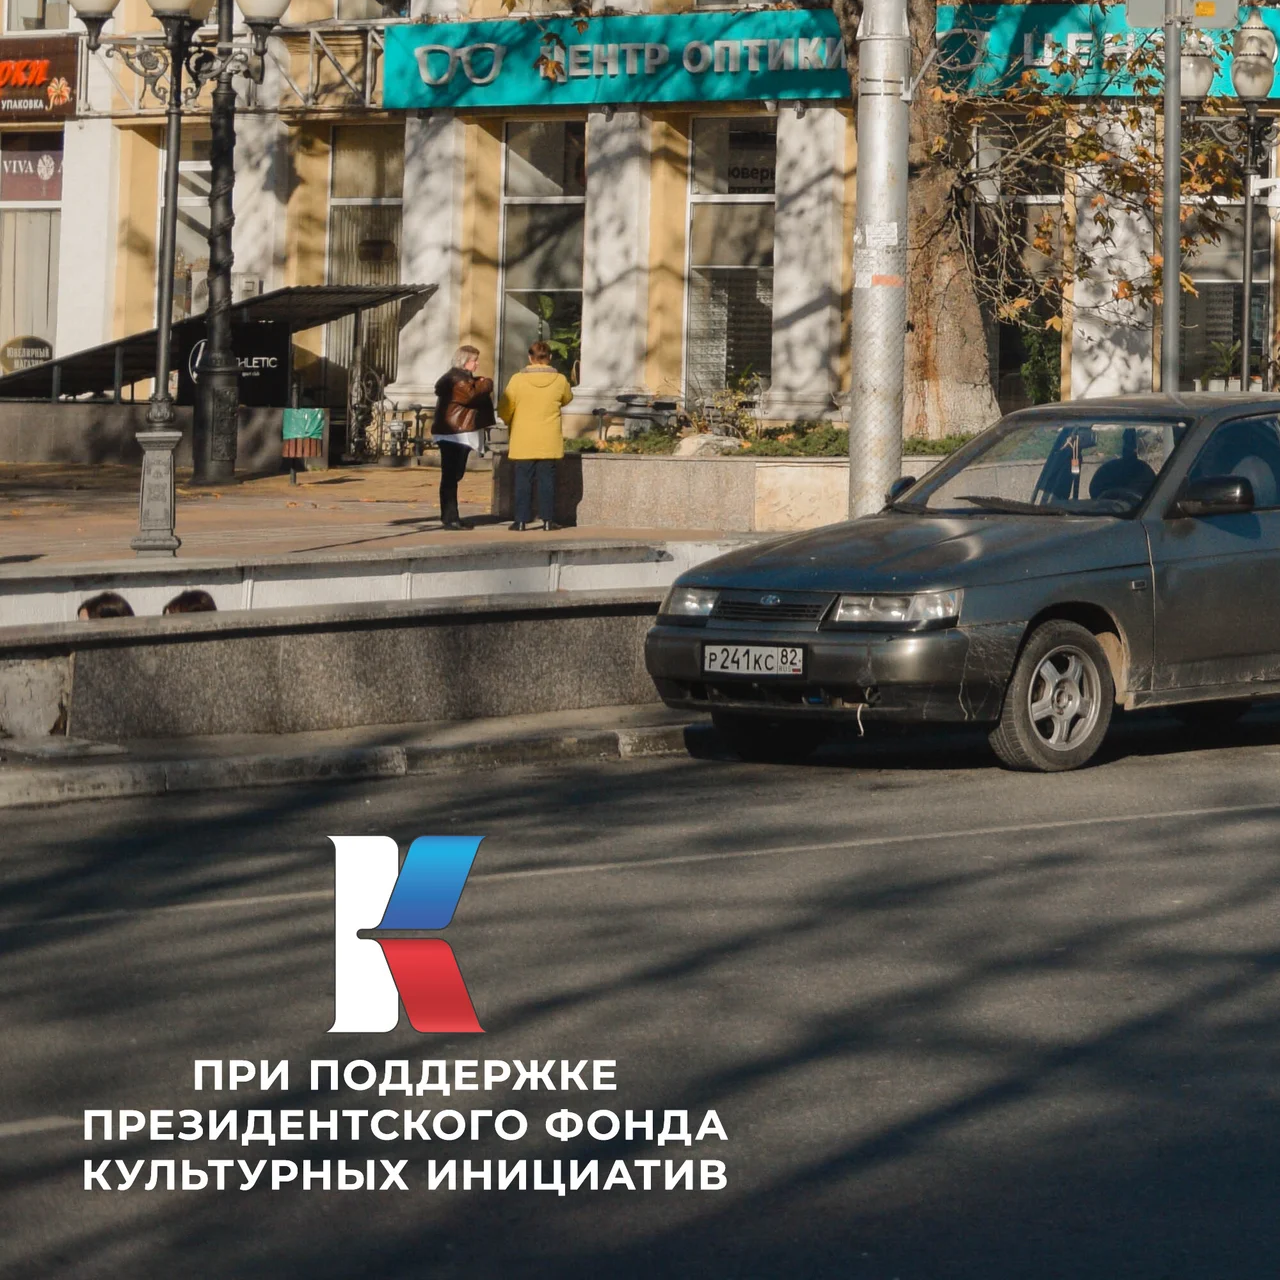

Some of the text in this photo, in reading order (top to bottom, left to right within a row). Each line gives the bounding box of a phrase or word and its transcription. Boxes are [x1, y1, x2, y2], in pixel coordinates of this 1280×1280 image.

[682, 37, 847, 73] ОПТИКИ
[1, 99, 44, 111] УПАКОВКА
[3, 160, 34, 174] VIVA
[709, 648, 797, 671] Р241КС 82
